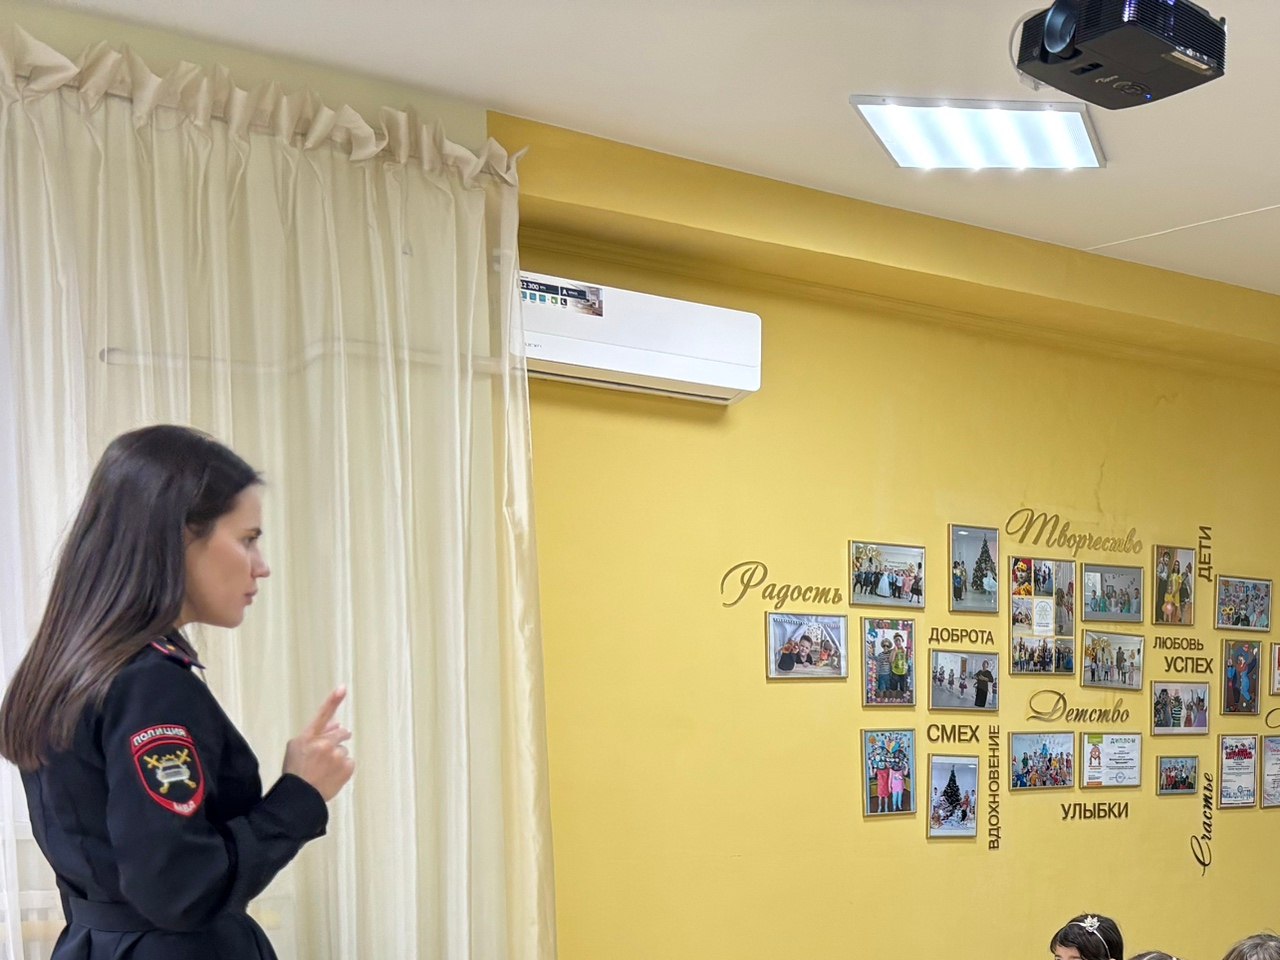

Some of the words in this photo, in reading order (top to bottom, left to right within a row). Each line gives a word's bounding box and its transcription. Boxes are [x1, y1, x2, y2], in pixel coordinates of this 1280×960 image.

[1005, 508, 1143, 558] Творчество
[1197, 526, 1213, 583] ДЕТИ
[720, 561, 843, 610] Радость
[928, 627, 995, 645] ДОБРОТА
[1153, 637, 1205, 652] ЛЮБОВЬ
[1164, 656, 1214, 674] УСПЕХ
[1026, 690, 1130, 724] Детство
[927, 724, 980, 743] СМЕХ
[988, 725, 1001, 851] ВДОХНОВЕНИЕ
[1061, 802, 1129, 820] УЛЫБКИ
[1190, 772, 1214, 877] Счастье
